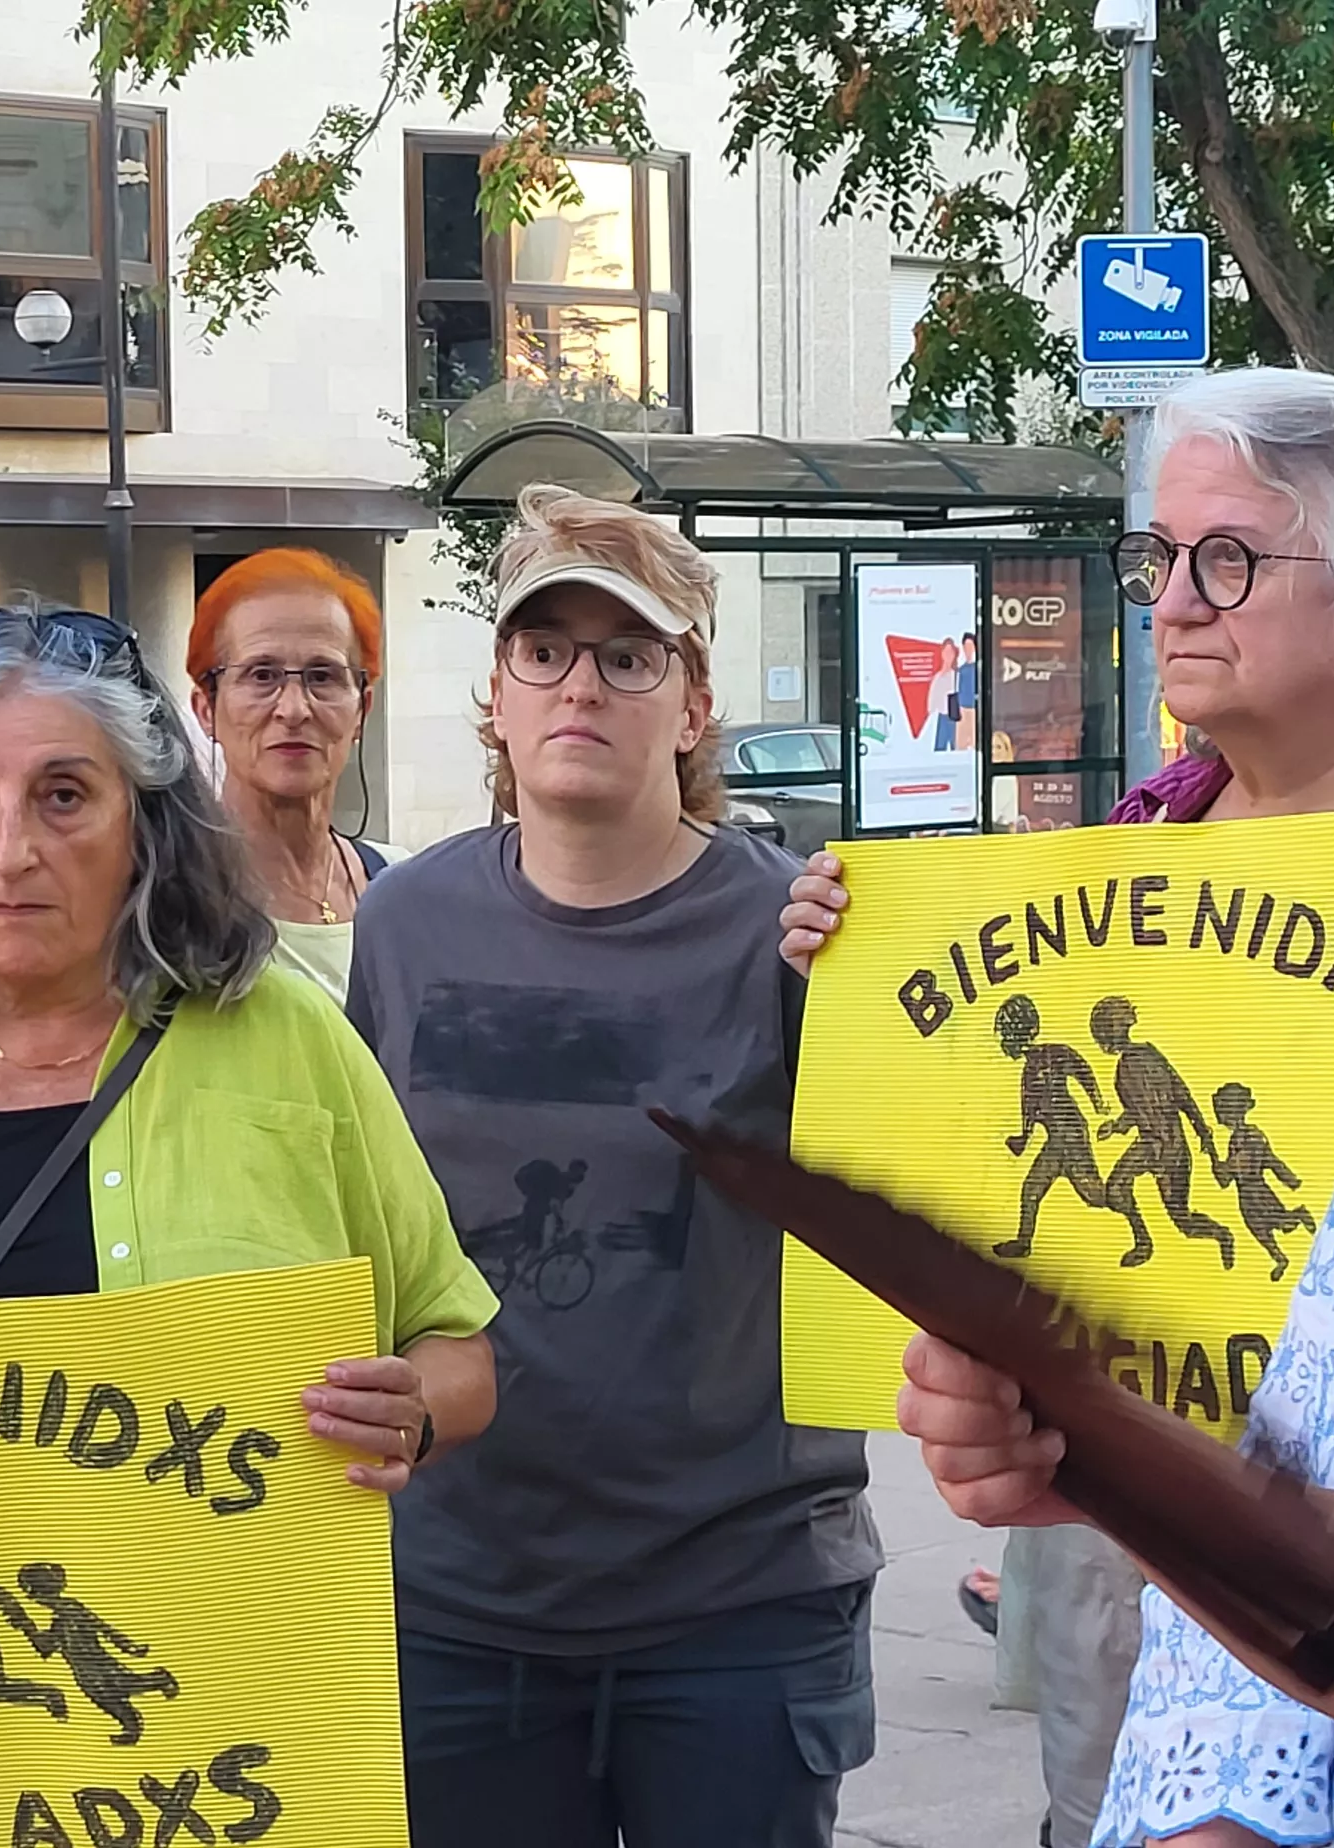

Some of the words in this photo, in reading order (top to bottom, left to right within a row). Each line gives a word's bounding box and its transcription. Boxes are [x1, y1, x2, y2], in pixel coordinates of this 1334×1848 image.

[1098, 330, 1132, 342] ZONA
[1134, 330, 1190, 341] VIGILADA
[1123, 370, 1194, 379] CONTROLADA
[1087, 381, 1108, 390] POR
[992, 594, 1066, 626] toGP
[1025, 671, 1052, 681] PLAY
[1033, 793, 1074, 805] AGOSTO
[1075, 1325, 1273, 1423] GIAD
